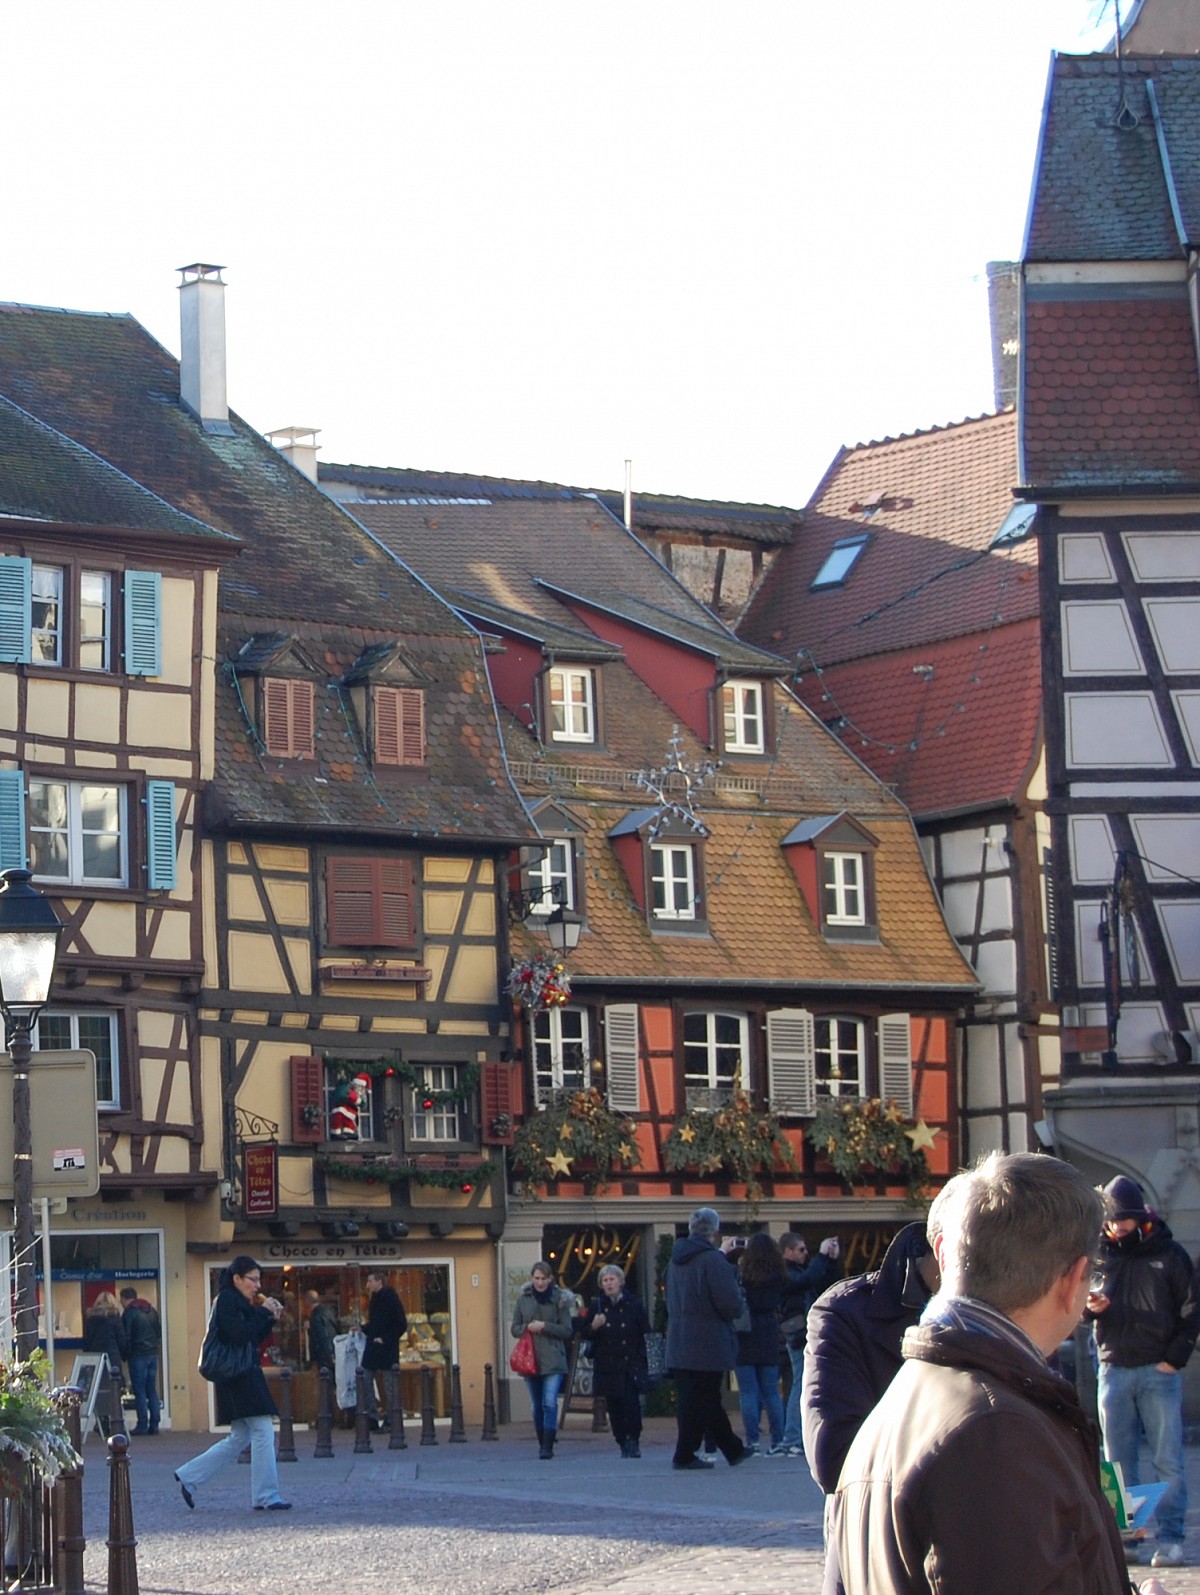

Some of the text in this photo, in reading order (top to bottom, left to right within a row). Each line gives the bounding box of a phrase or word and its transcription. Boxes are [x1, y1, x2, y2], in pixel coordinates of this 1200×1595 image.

[268, 1244, 397, 1258] Choco en Têtes
